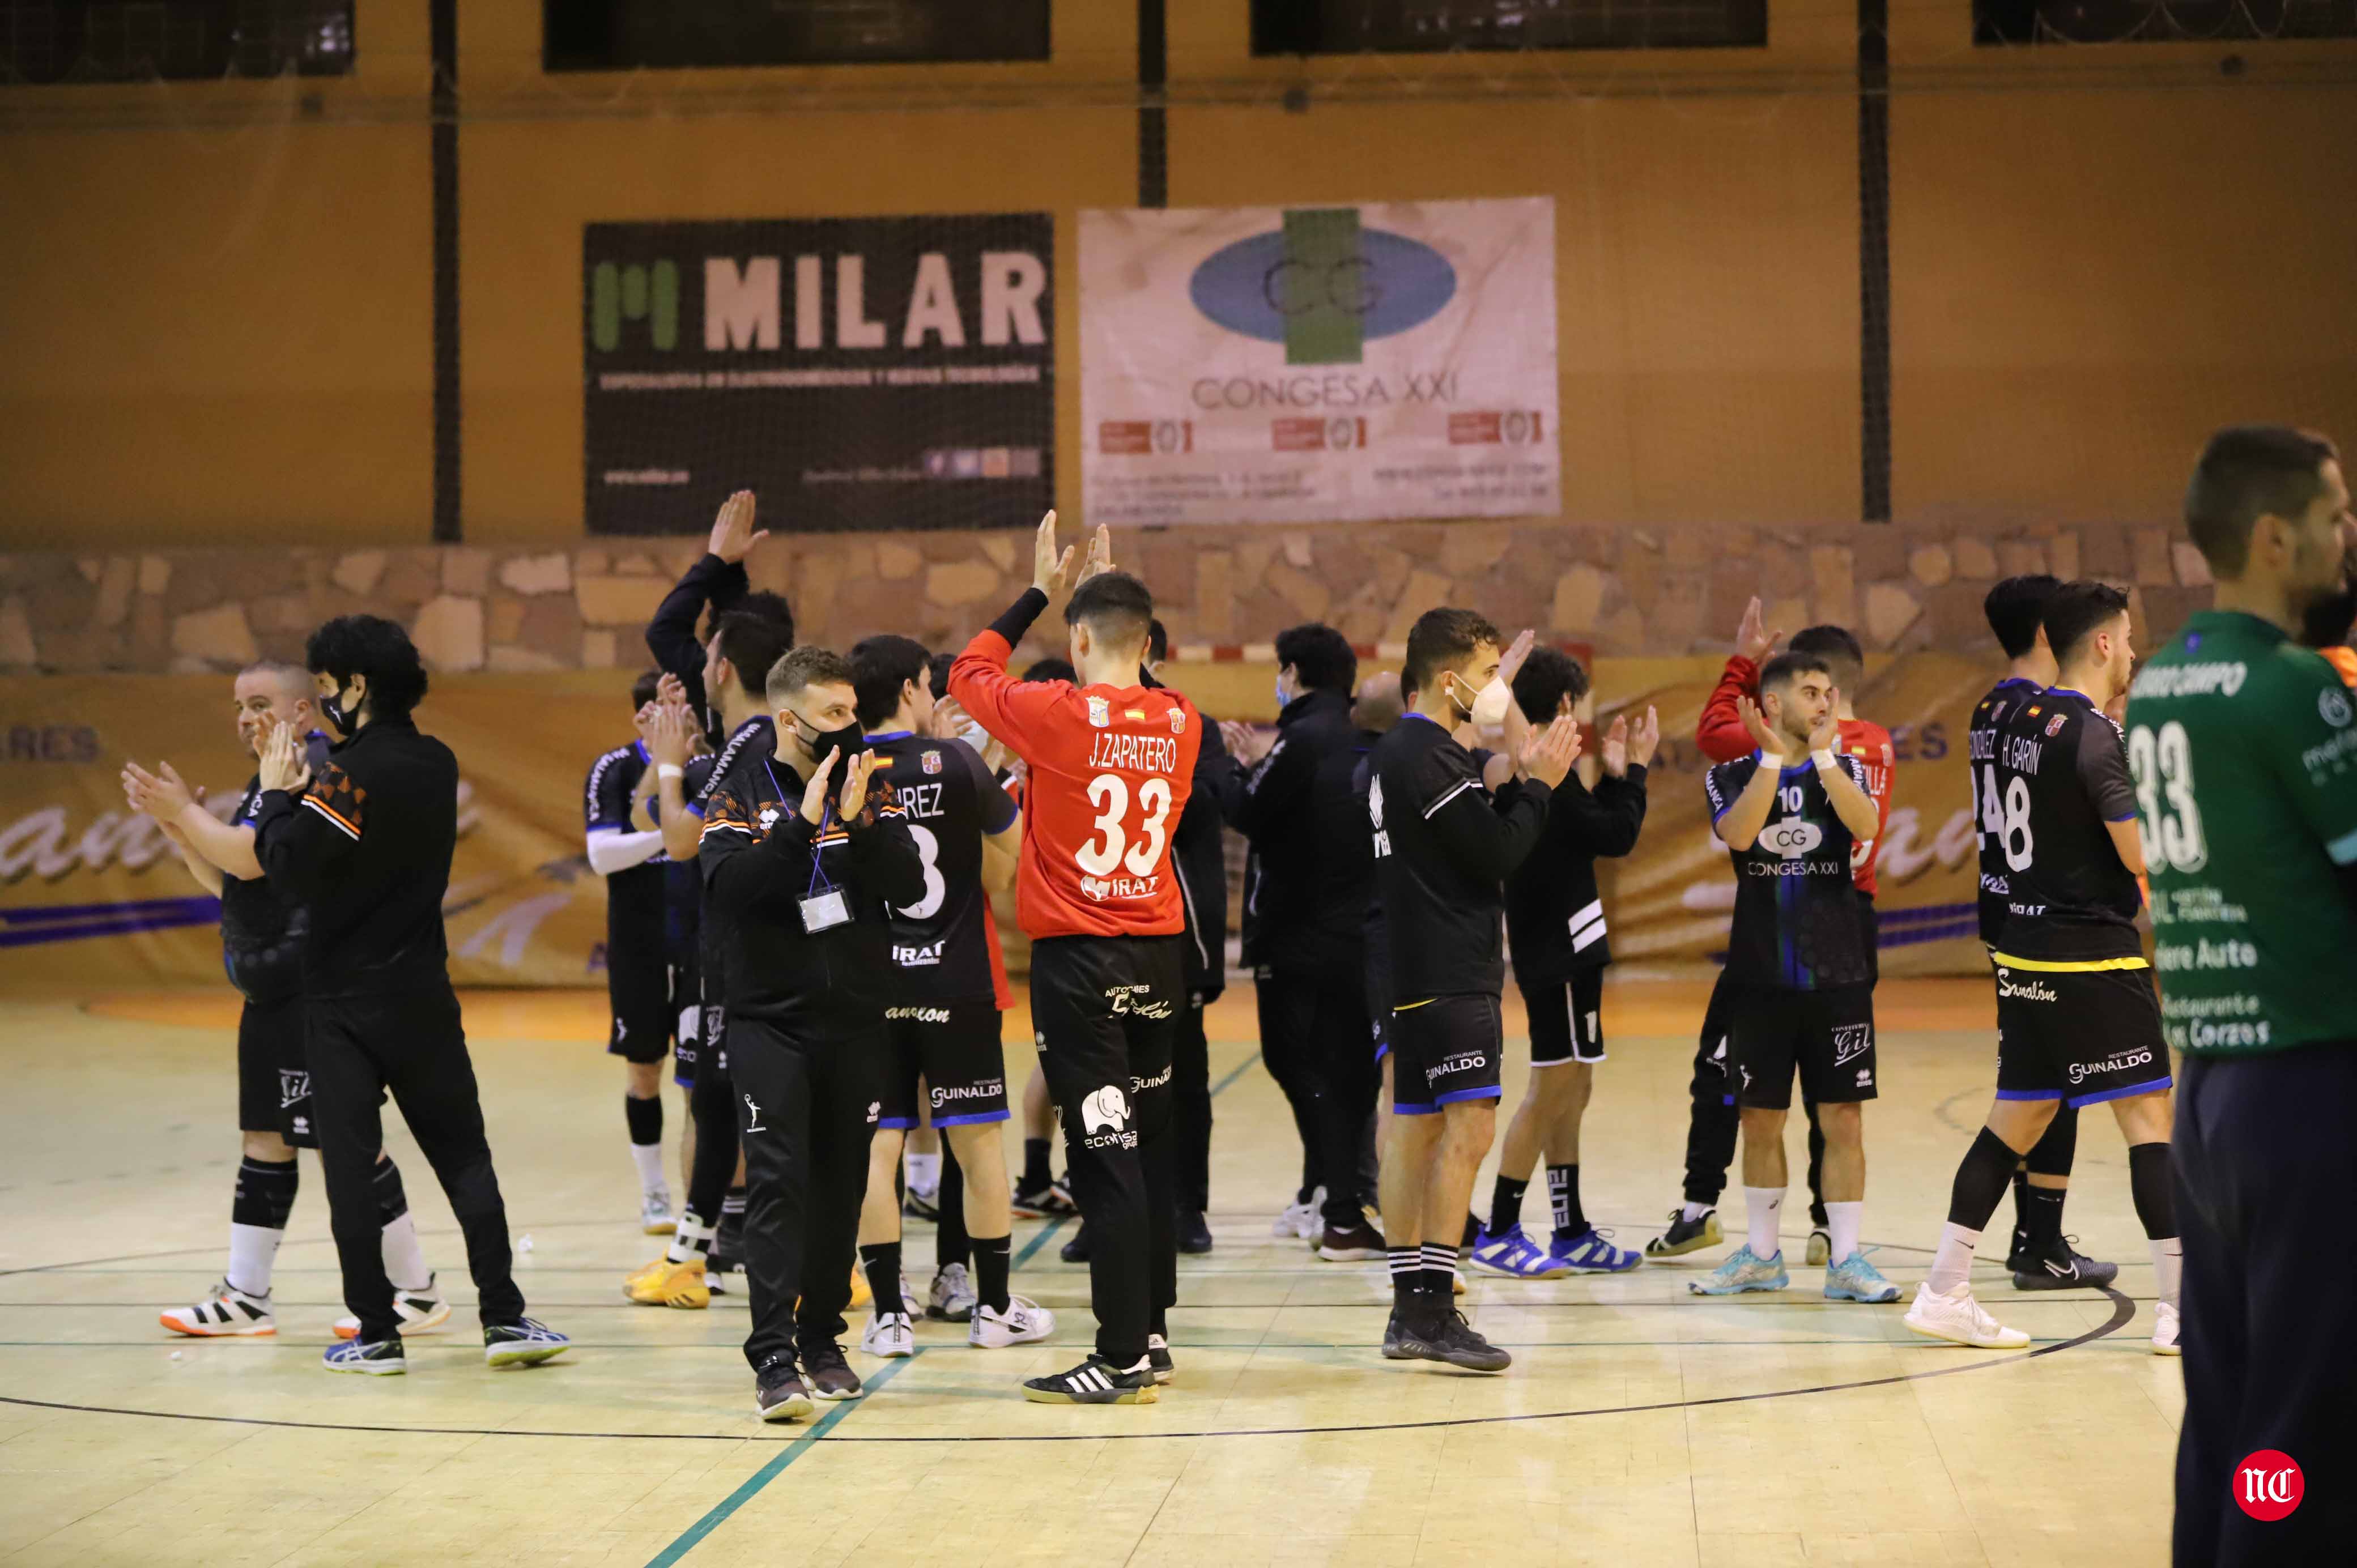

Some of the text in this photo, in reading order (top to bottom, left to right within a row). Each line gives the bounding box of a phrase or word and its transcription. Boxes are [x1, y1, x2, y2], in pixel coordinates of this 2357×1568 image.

[705, 251, 1045, 351] MILAR
[1192, 373, 1459, 410] CONGESA XXI
[1089, 731, 1177, 773] J.ZAPATERO
[2002, 734, 2042, 776] H. GARÍN
[1777, 786, 1803, 813] 10
[2128, 720, 2208, 875] 33
[1074, 773, 1172, 877] 33
[1776, 829, 1807, 847] CG
[2005, 776, 2033, 872] 8
[1748, 860, 1839, 877] CONGESA XXI
[1835, 1030, 1871, 1061] Gil
[2069, 1051, 2152, 1079] GUINALDO
[930, 1084, 1003, 1108] GUINALDO
